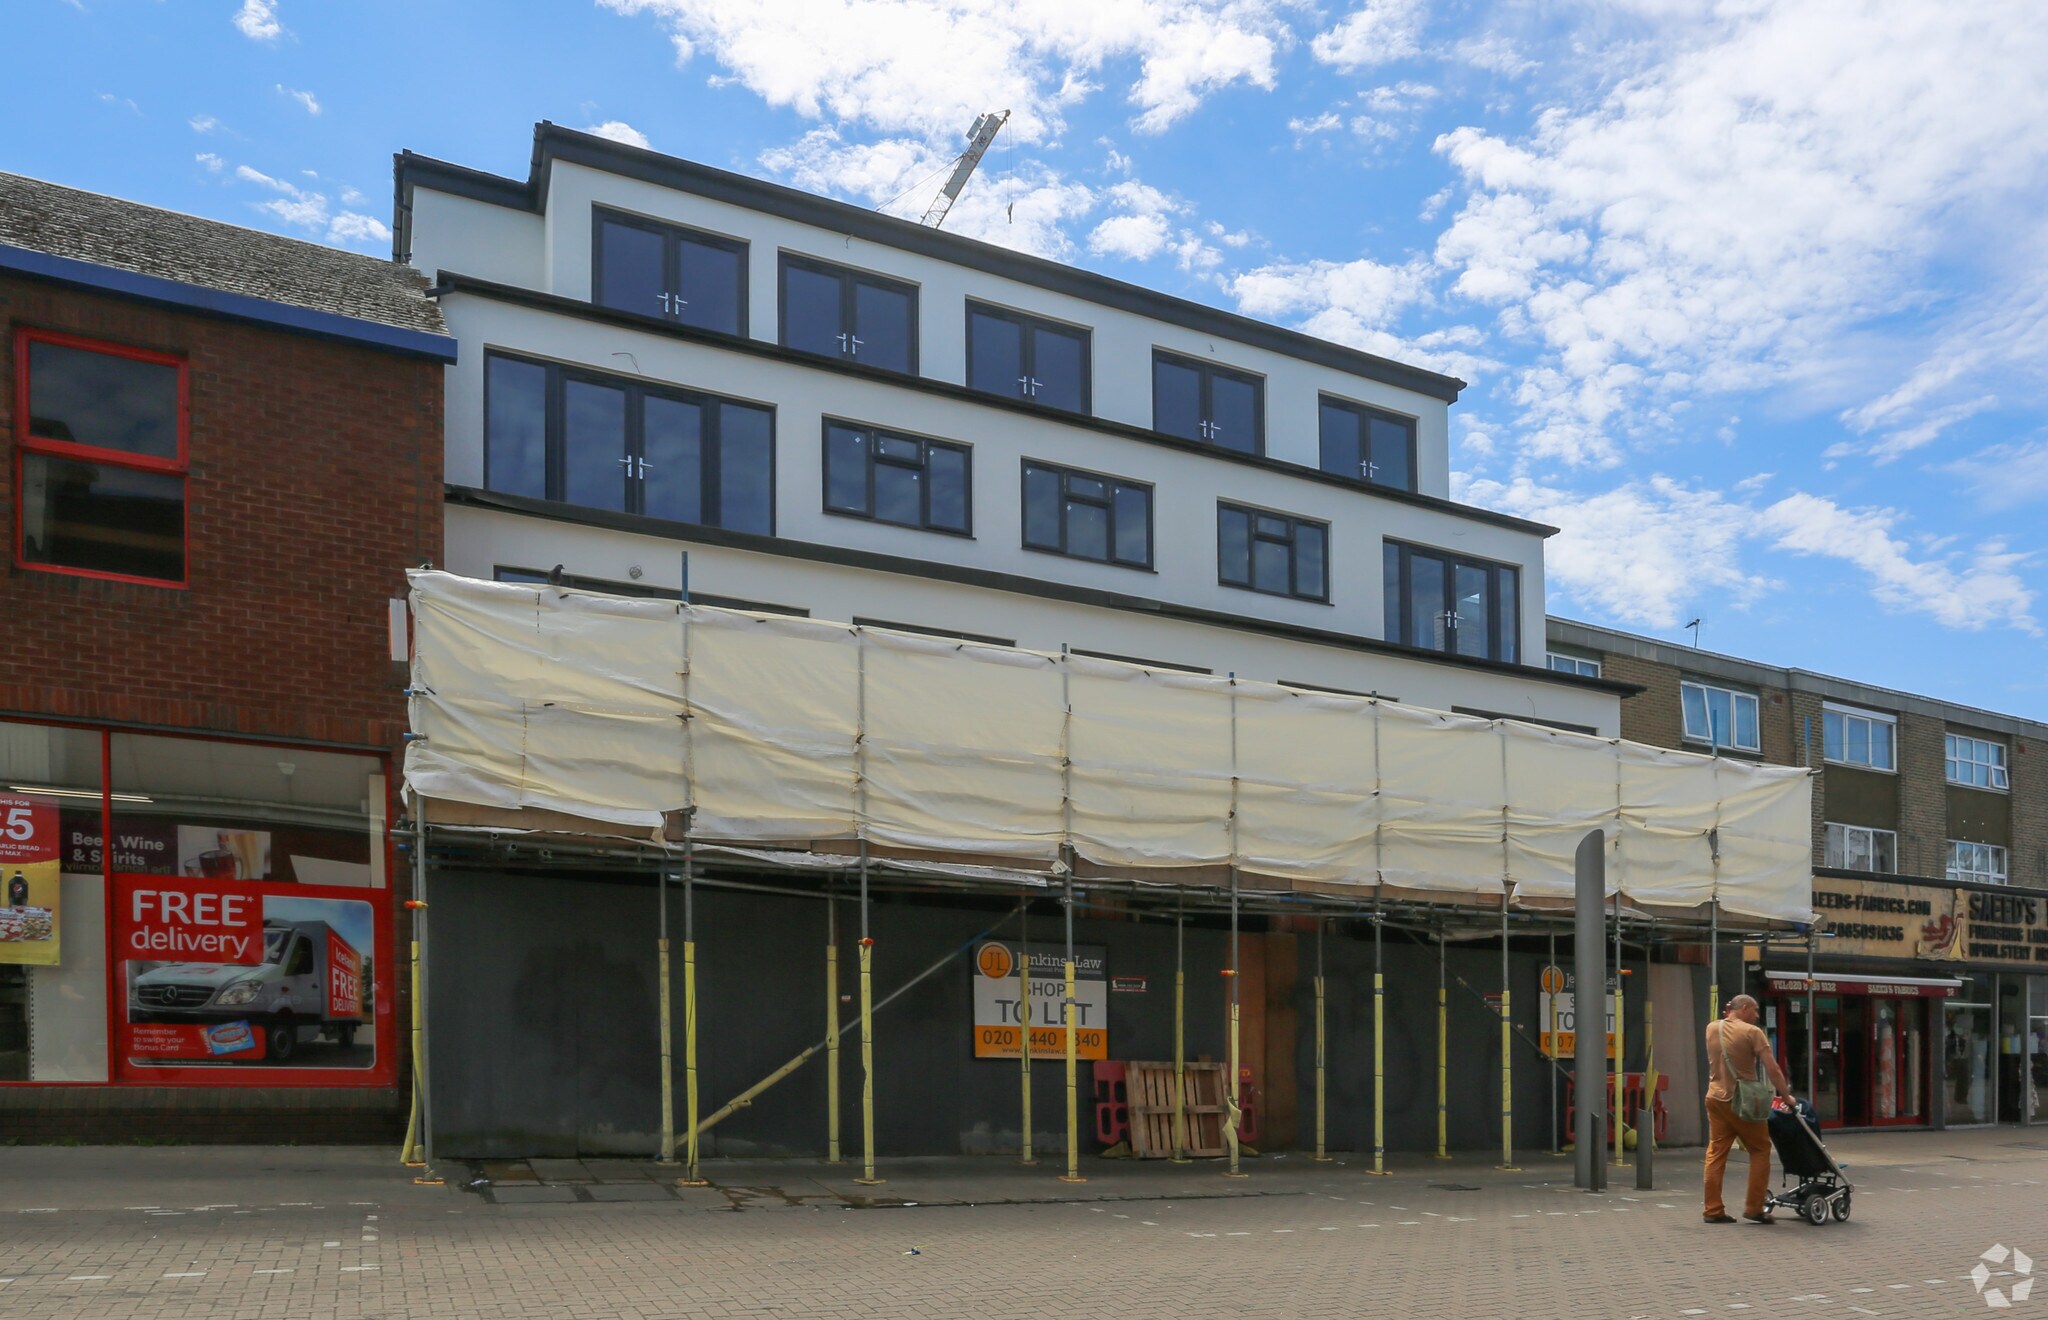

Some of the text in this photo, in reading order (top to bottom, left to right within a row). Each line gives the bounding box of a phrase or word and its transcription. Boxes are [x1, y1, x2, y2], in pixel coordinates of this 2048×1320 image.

[72, 832, 165, 851] Bee, Wine
[73, 848, 146, 866] & Sirits
[130, 925, 250, 959] delivery
[1016, 951, 1067, 971] Jnkins
[1075, 955, 1102, 969] Law
[332, 967, 359, 1001] FREE
[995, 1000, 1033, 1024] TO
[133, 1027, 177, 1036] Remember
[982, 1029, 1013, 1045] 020
[1018, 1031, 1057, 1046] 440
[133, 1044, 179, 1052] Bonus Card
[166, 1037, 185, 1045] your
